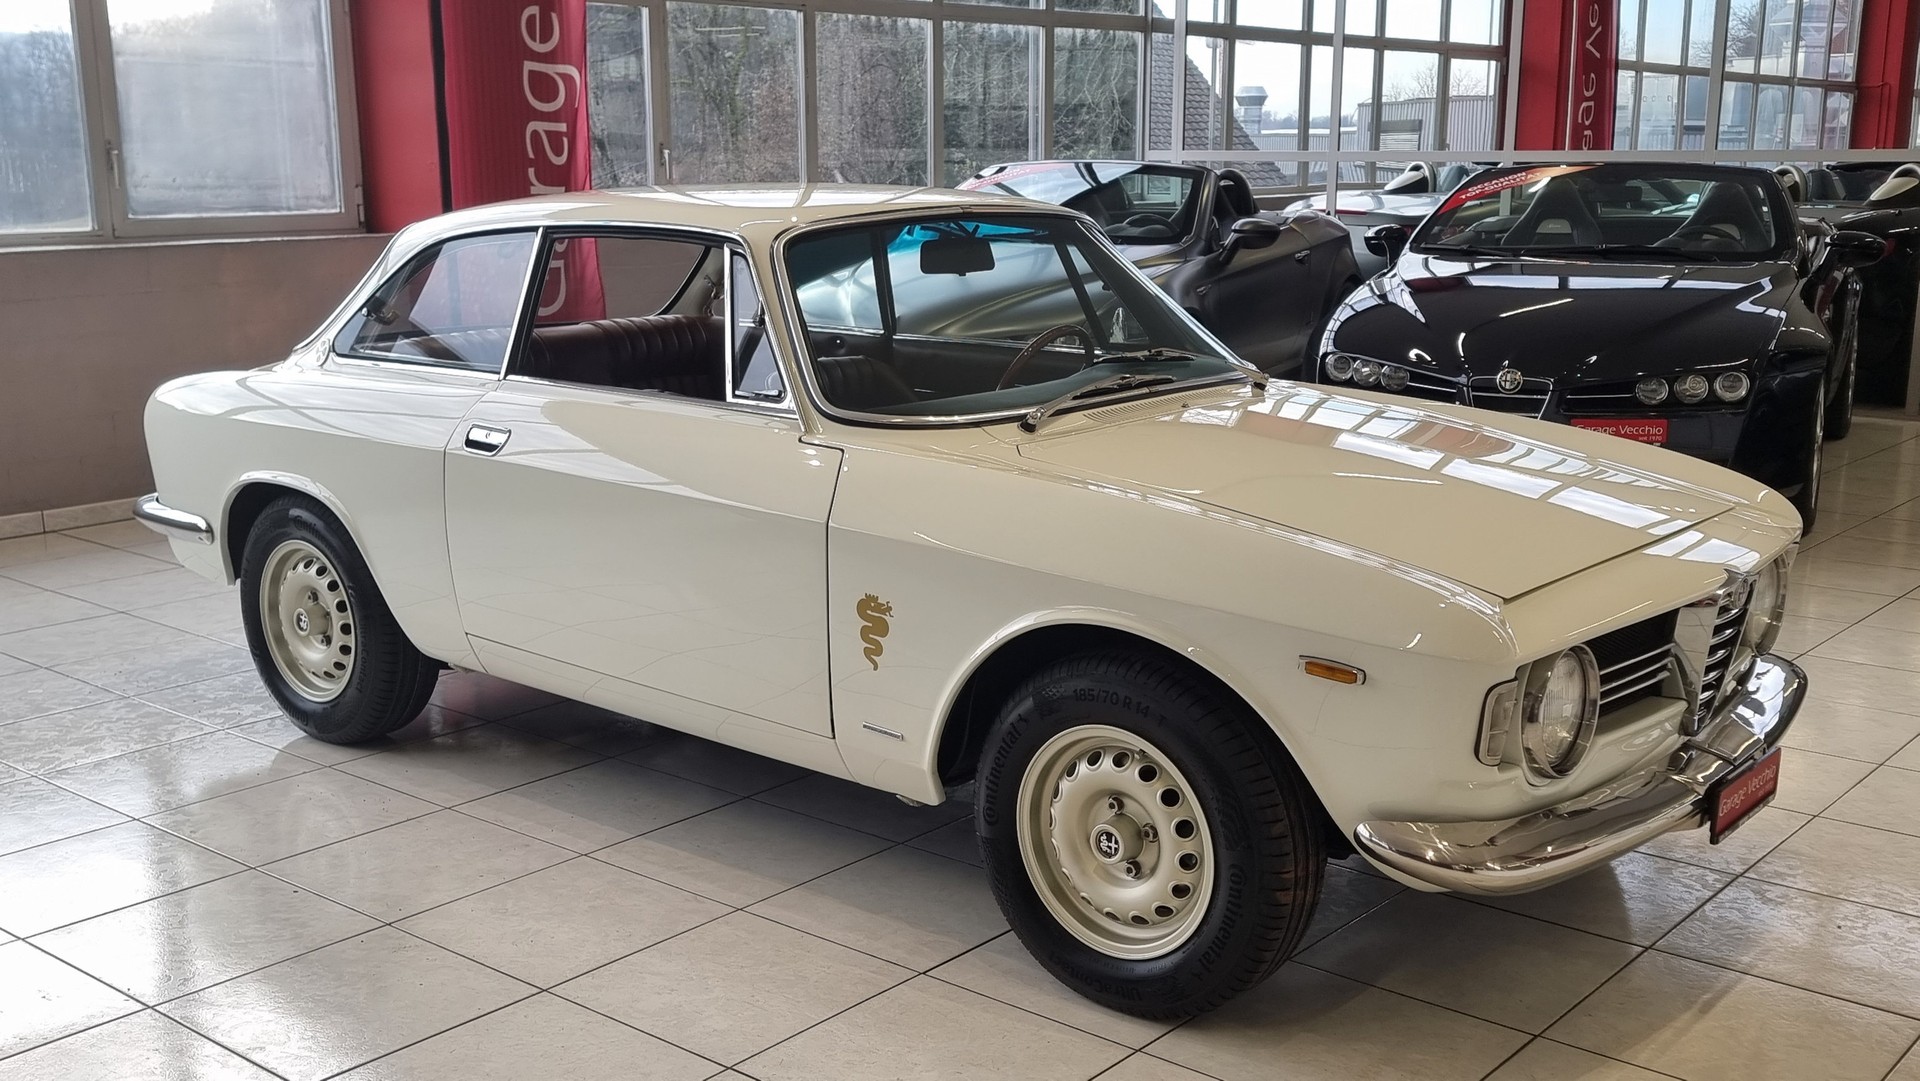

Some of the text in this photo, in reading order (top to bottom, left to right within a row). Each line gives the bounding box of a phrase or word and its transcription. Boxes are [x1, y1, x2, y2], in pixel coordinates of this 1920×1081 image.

[1467, 171, 1526, 192] OCCASION
[1619, 425, 1663, 434] Vecchio
[1073, 687, 1119, 706] 185/70
[1122, 695, 1133, 711] R
[1135, 702, 1151, 719] 14
[983, 722, 1022, 826] Continental
[1719, 787, 1747, 816] Garage
[1748, 765, 1777, 794] Vecchio
[1198, 864, 1247, 971] Continental
